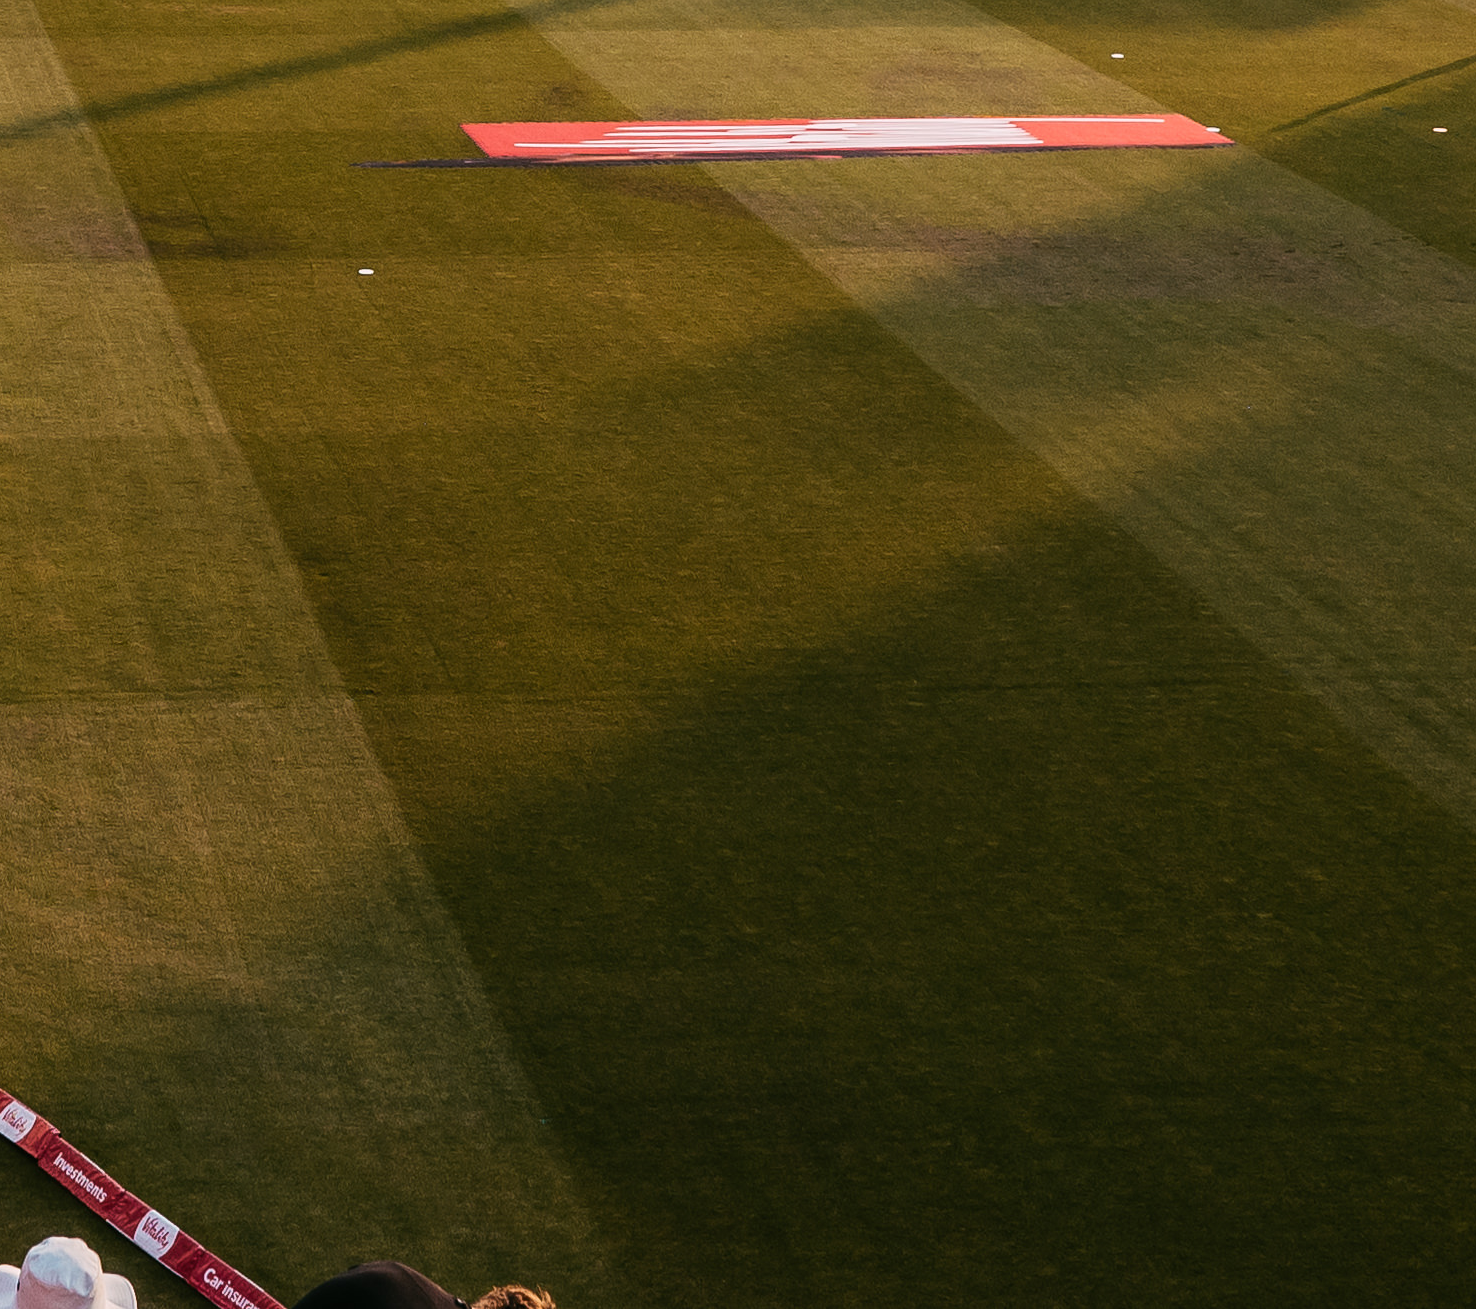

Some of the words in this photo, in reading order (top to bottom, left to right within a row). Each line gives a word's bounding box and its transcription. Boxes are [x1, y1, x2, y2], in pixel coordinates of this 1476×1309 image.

[53, 1152, 108, 1204] Investments
[203, 1267, 224, 1290] Car
[221, 1280, 261, 1309] insura
